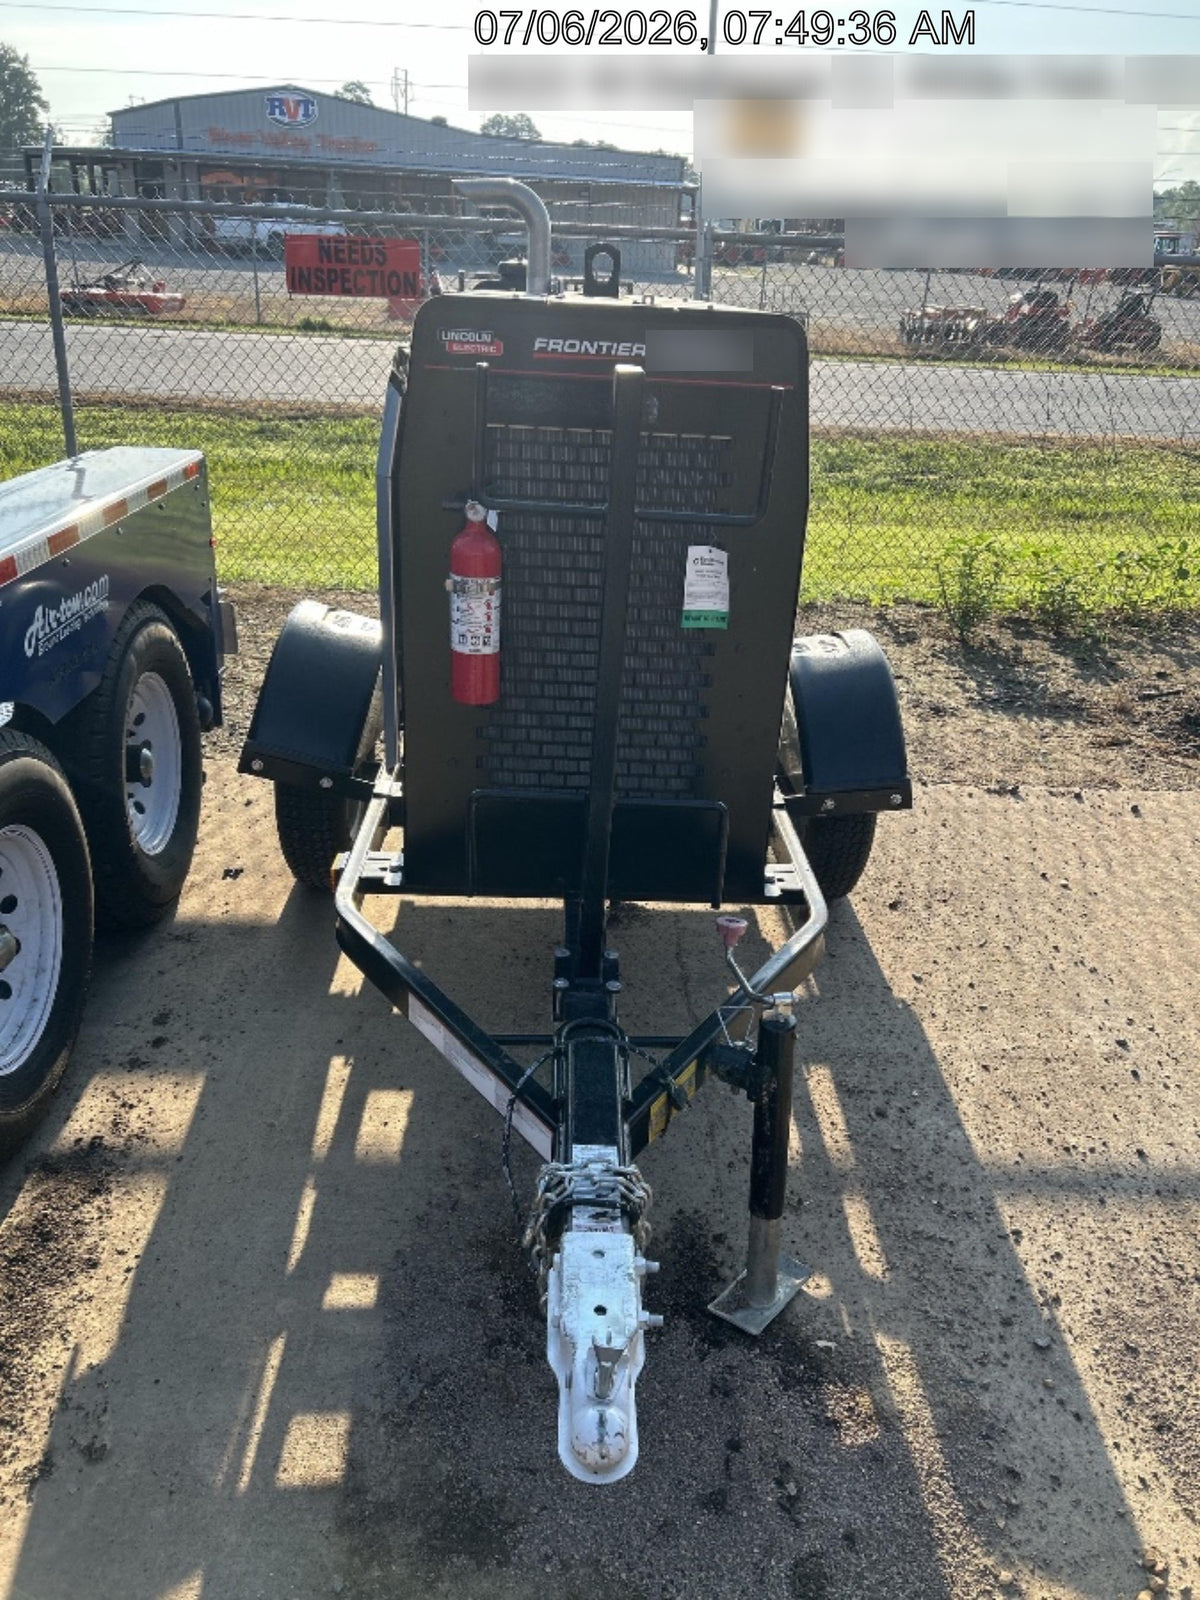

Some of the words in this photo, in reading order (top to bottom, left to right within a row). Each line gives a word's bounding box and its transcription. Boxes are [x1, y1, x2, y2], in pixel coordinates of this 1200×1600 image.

[267, 97, 317, 121] RVT
[317, 238, 387, 267] NEEDS
[289, 266, 418, 297] INSPECTION
[442, 331, 492, 343] LINCOLN
[453, 343, 497, 354] ELECTRIC
[534, 337, 646, 357] FRONTIER
[24, 574, 109, 658] Air-tow.com
